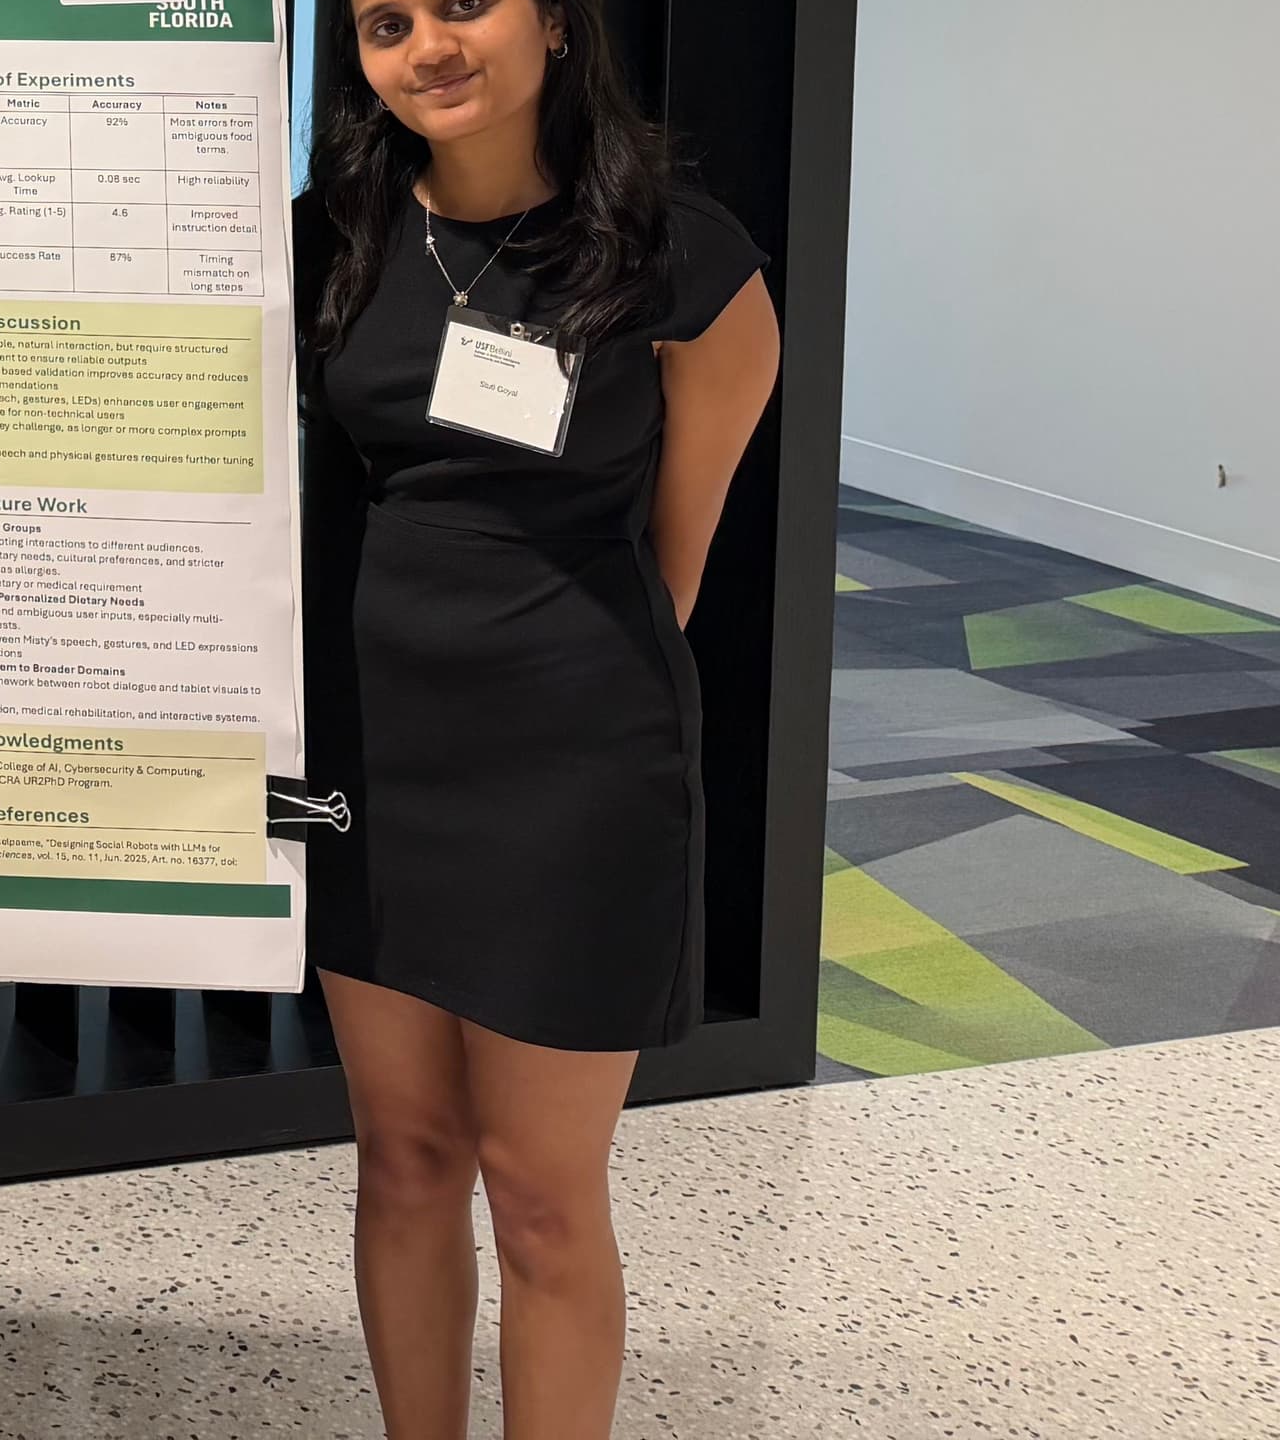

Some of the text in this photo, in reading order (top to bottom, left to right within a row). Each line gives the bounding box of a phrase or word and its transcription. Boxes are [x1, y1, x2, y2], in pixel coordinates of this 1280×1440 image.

[149, 12, 233, 28] FLORIDA
[17, 72, 135, 90] Experiments
[7, 98, 39, 108] Metric
[91, 99, 142, 111] Accuracy
[195, 100, 227, 109] Notes
[0, 115, 47, 127] Accuracy
[105, 117, 128, 126] 92%
[169, 117, 253, 128] Most errors from
[171, 131, 252, 142] ambiguous food
[17, 173, 56, 184] Lookup
[177, 175, 250, 187] High reliability
[13, 185, 37, 195] Time
[8, 205, 41, 217] Rating
[43, 206, 66, 218] (1-5)
[191, 209, 238, 220] Improved
[172, 223, 257, 233] instruction detail
[38, 250, 61, 260] Rate
[109, 252, 132, 262] 87%
[198, 254, 233, 266] Timing
[183, 268, 249, 278] mismatch on
[190, 281, 243, 293] long steps
[496, 385, 519, 397] Goyal
[36, 496, 87, 513] Work
